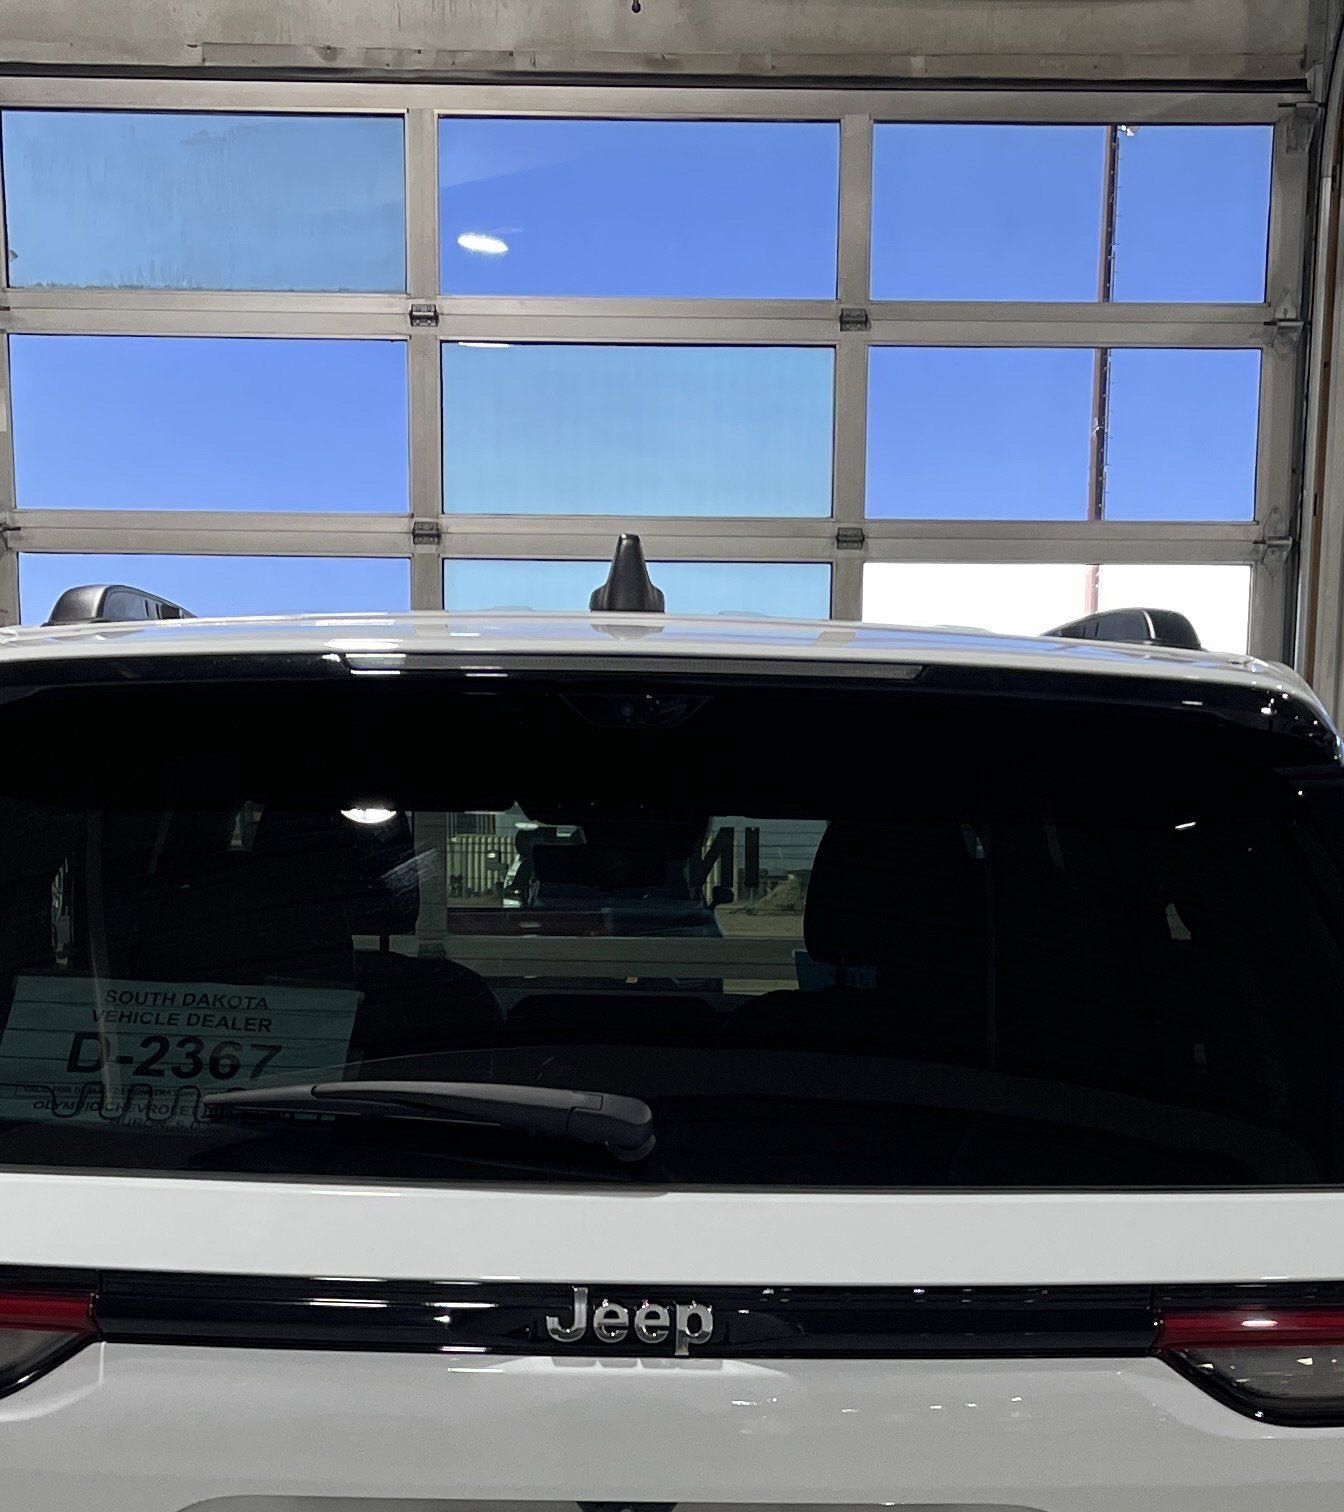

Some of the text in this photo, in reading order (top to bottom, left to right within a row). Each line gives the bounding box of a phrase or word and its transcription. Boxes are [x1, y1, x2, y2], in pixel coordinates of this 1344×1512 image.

[105, 988, 269, 1011] SOUTH DAKOTA
[91, 1008, 273, 1034] VEHICLE DEALER
[66, 1031, 282, 1082] D-2367
[546, 1286, 714, 1356] Jeep
